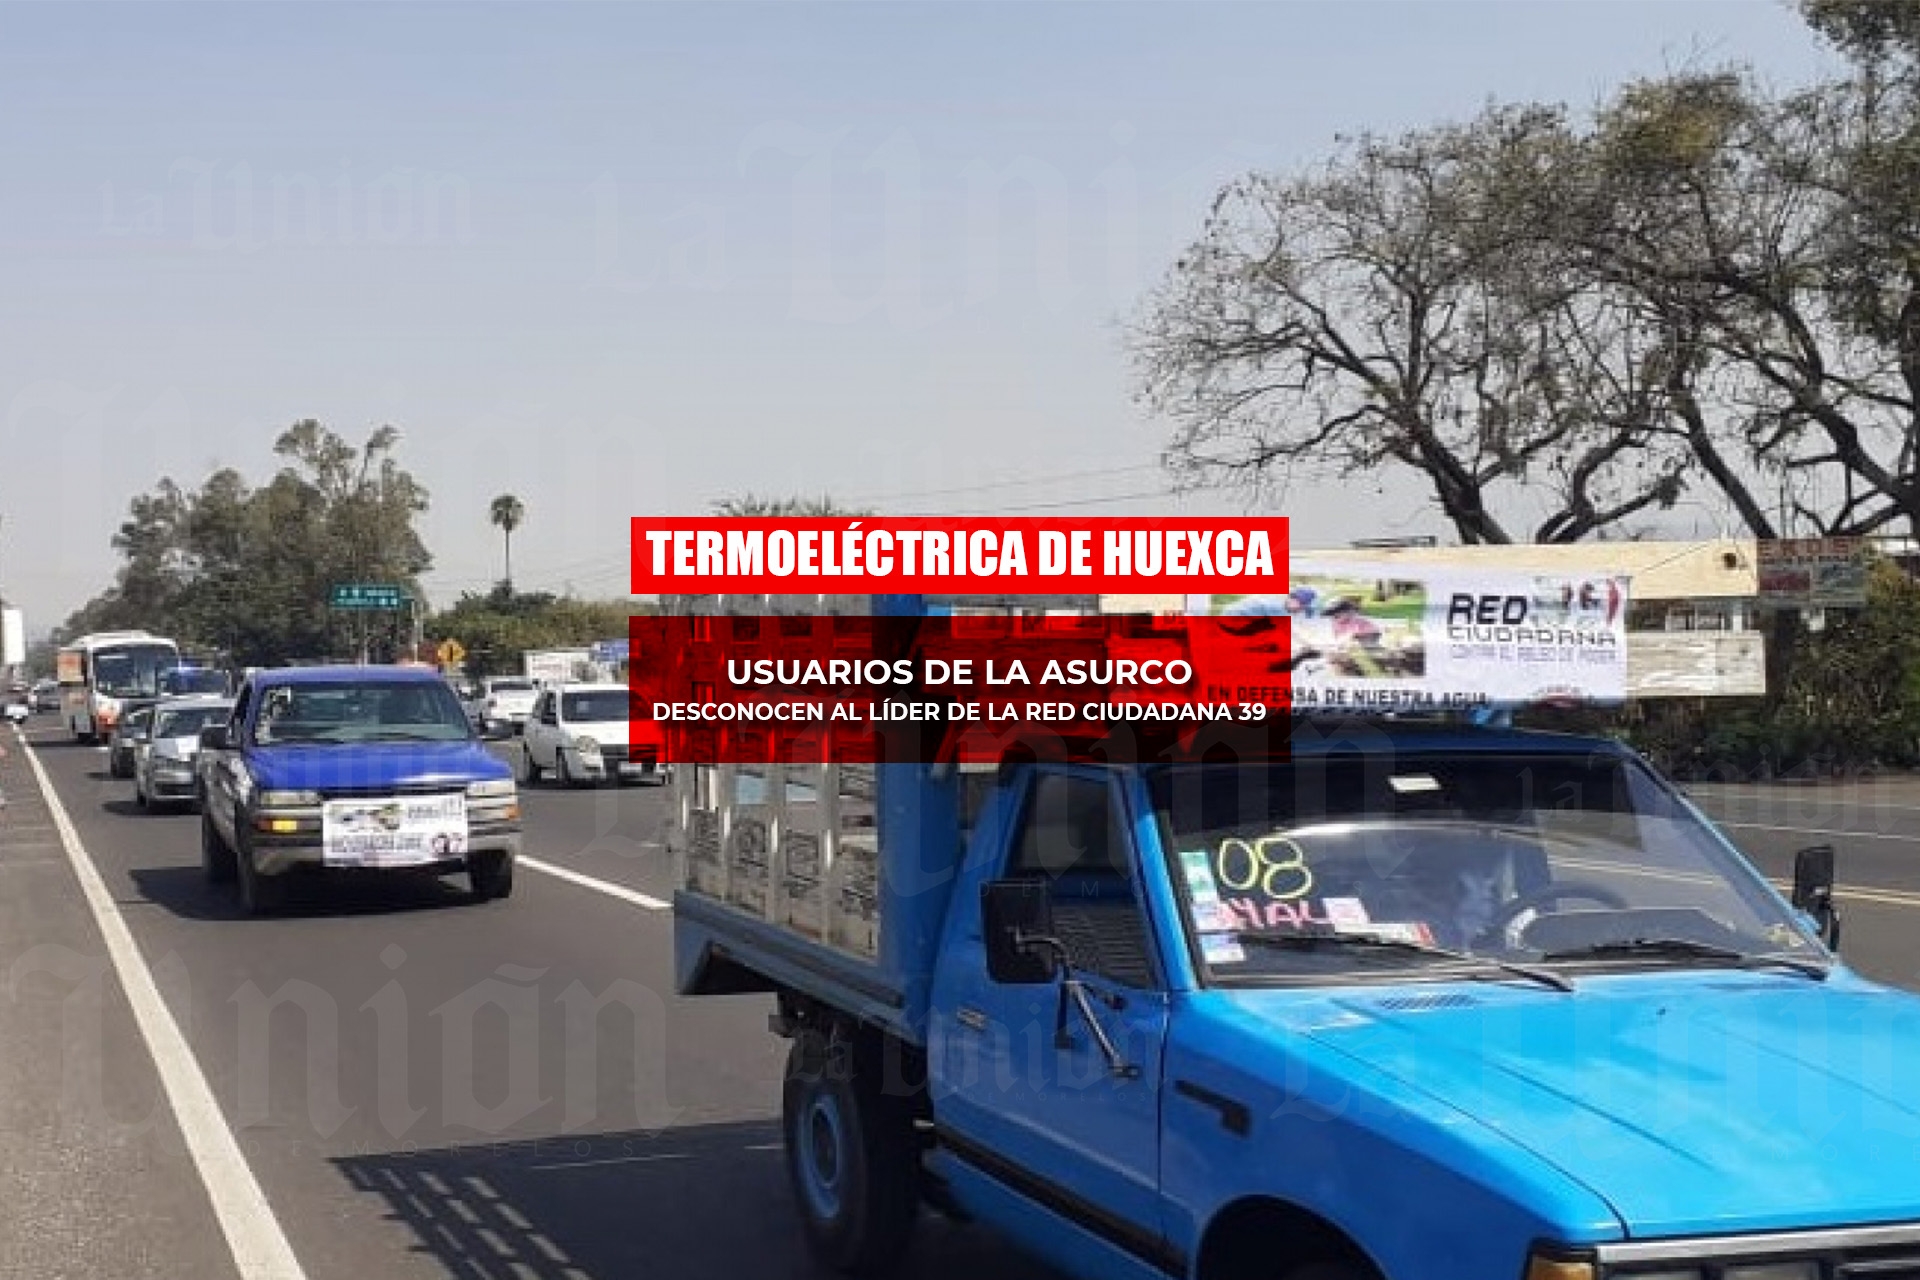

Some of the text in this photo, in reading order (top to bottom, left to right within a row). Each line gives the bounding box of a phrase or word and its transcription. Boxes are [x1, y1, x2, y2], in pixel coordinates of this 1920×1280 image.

[1449, 593, 1528, 625] RED
[1449, 626, 1616, 646] CIUDADANA
[1325, 688, 1345, 705] DE
[1217, 837, 1313, 899] 08
